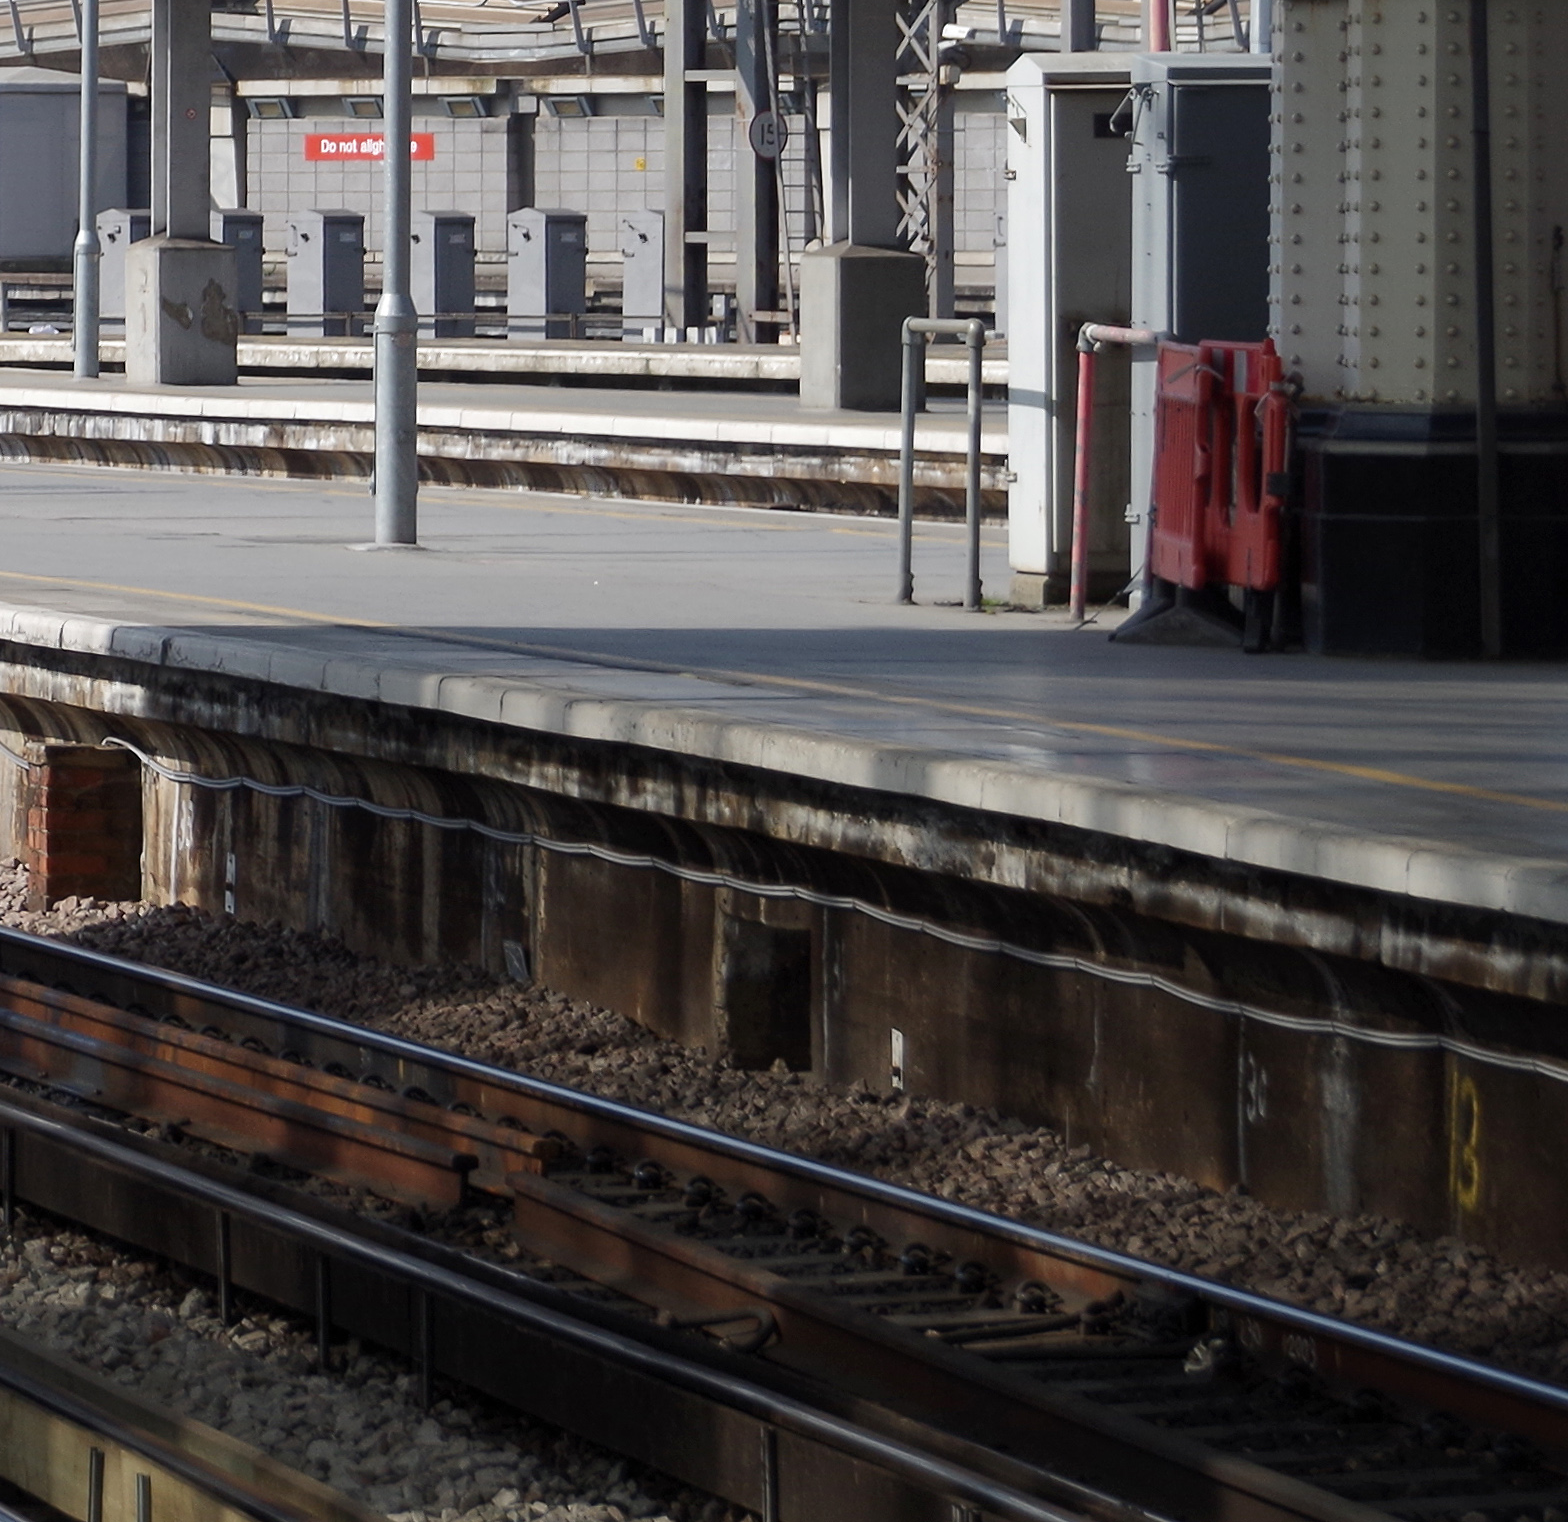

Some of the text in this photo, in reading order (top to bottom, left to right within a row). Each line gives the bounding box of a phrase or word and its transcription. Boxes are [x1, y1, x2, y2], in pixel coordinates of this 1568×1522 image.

[320, 139, 384, 156] Do not aligh
